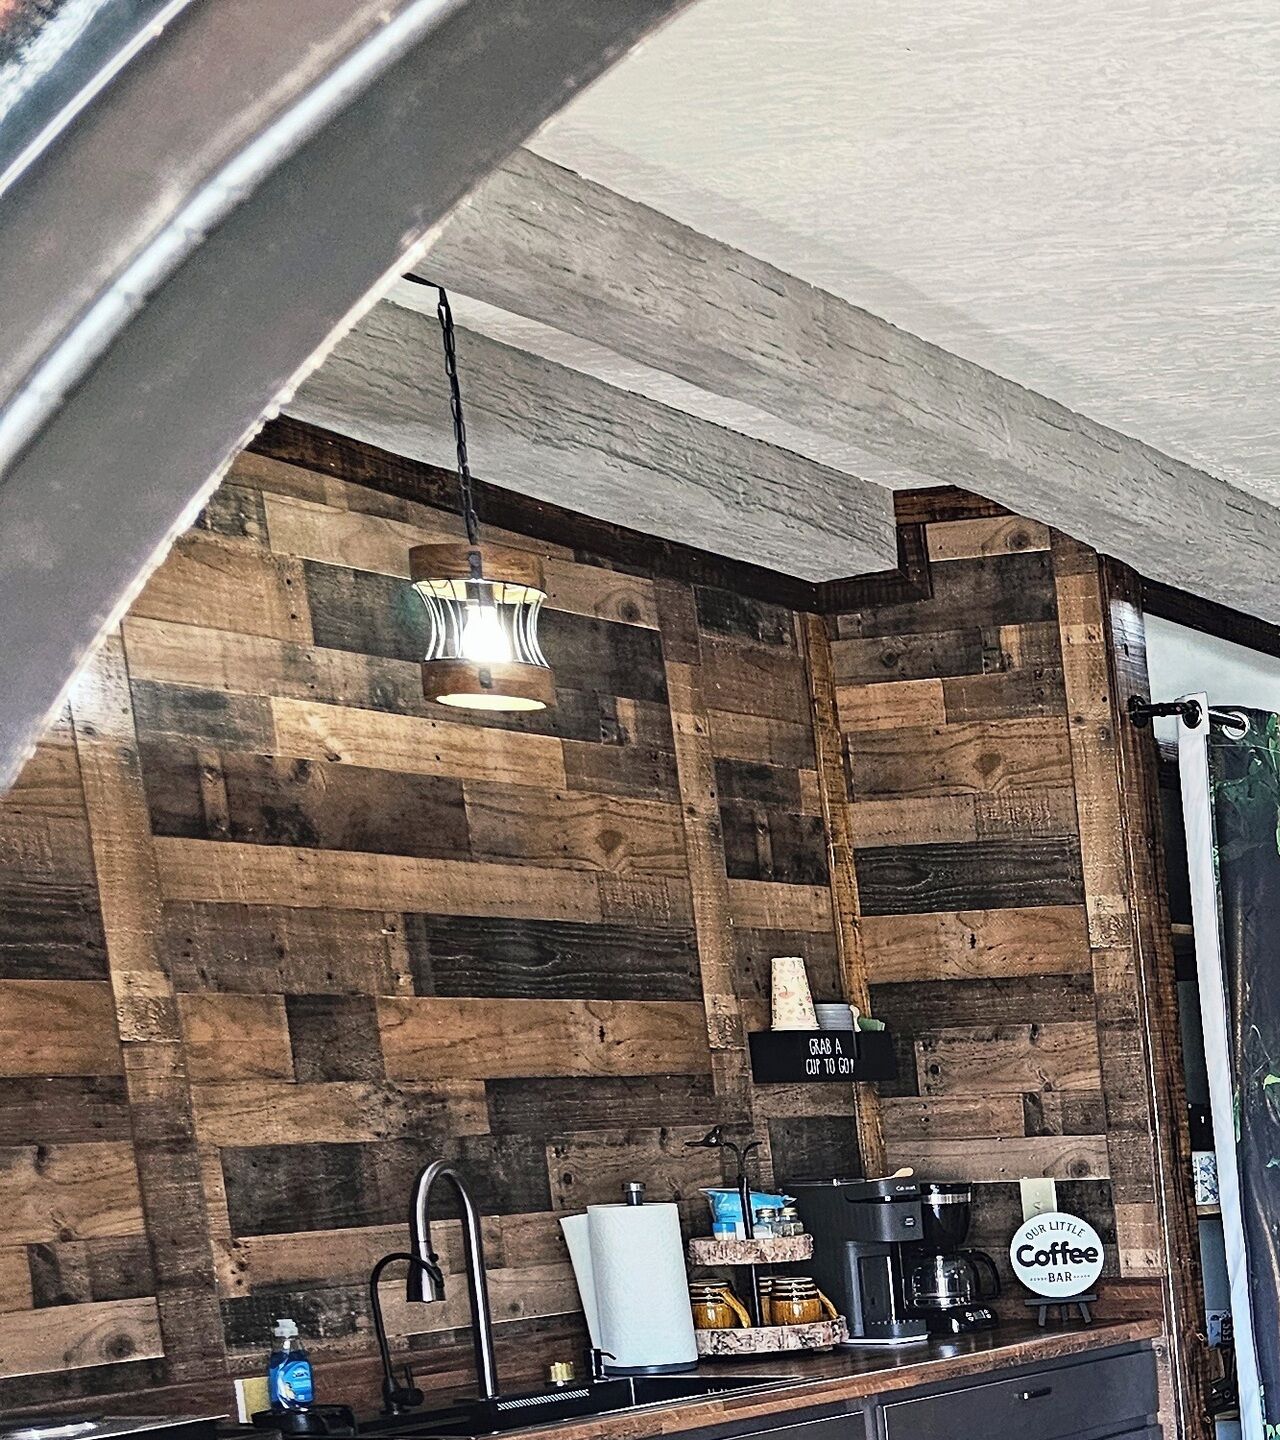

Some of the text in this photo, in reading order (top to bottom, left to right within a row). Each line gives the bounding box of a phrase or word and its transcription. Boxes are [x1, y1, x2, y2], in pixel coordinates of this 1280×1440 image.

[809, 1037, 843, 1056] GRAB A
[805, 1056, 854, 1075] CUP TO GO!
[1025, 1220, 1086, 1241] OUR LITTLE
[1016, 1240, 1099, 1268] Coffee
[1047, 1271, 1073, 1283] BAR
